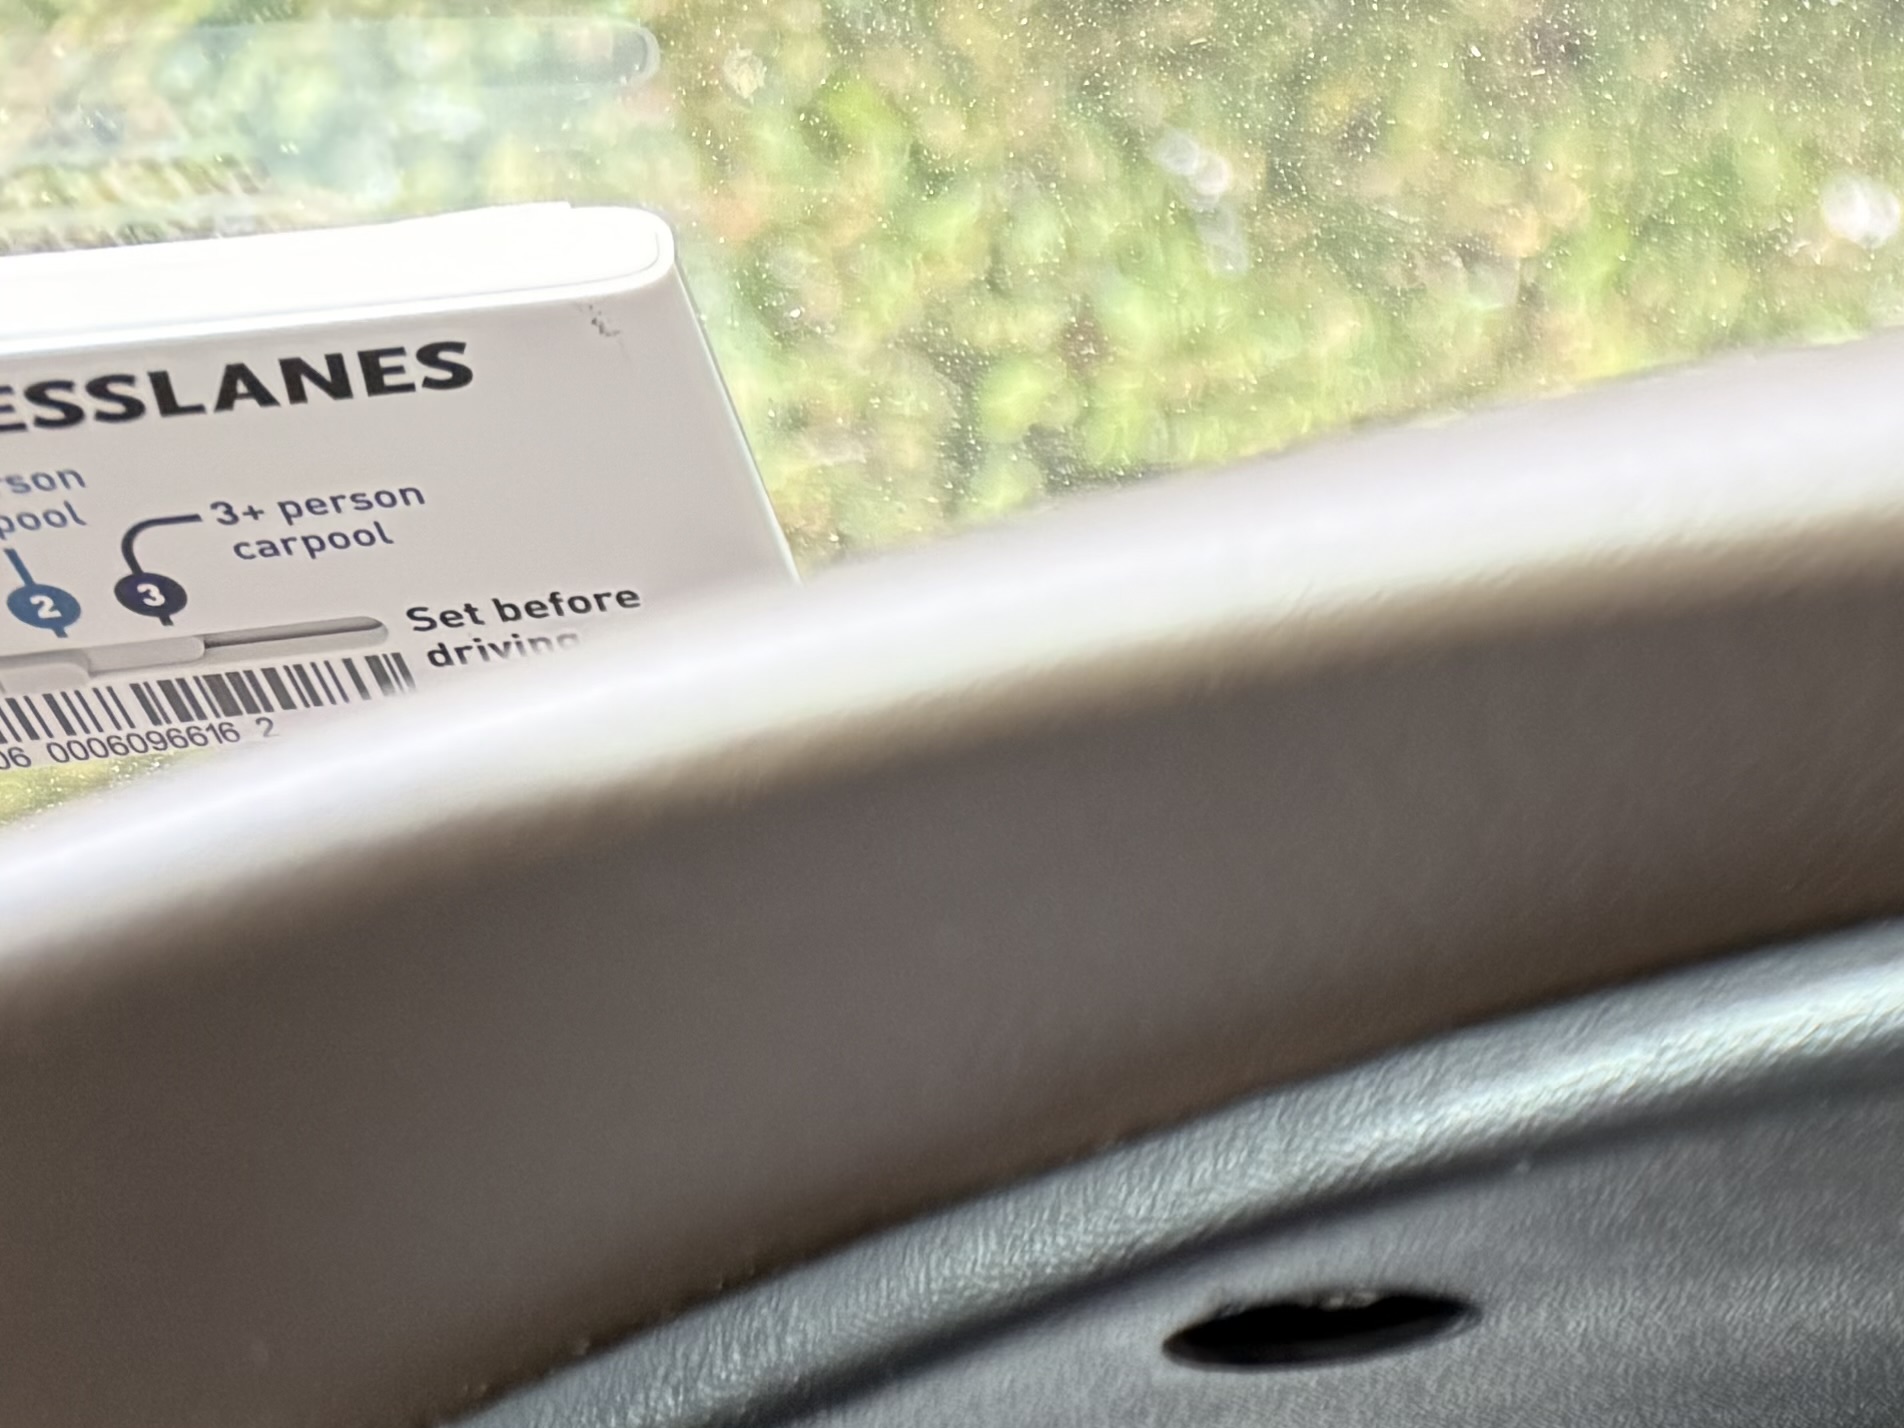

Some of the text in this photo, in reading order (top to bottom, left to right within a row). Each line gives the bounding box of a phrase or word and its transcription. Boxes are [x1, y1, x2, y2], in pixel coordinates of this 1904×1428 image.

[211, 486, 426, 526] 3+ person
[233, 521, 394, 560] carpool
[29, 594, 62, 619] 2
[136, 583, 166, 607] 3
[406, 590, 641, 632] Set before
[46, 722, 241, 763] 0006096616
